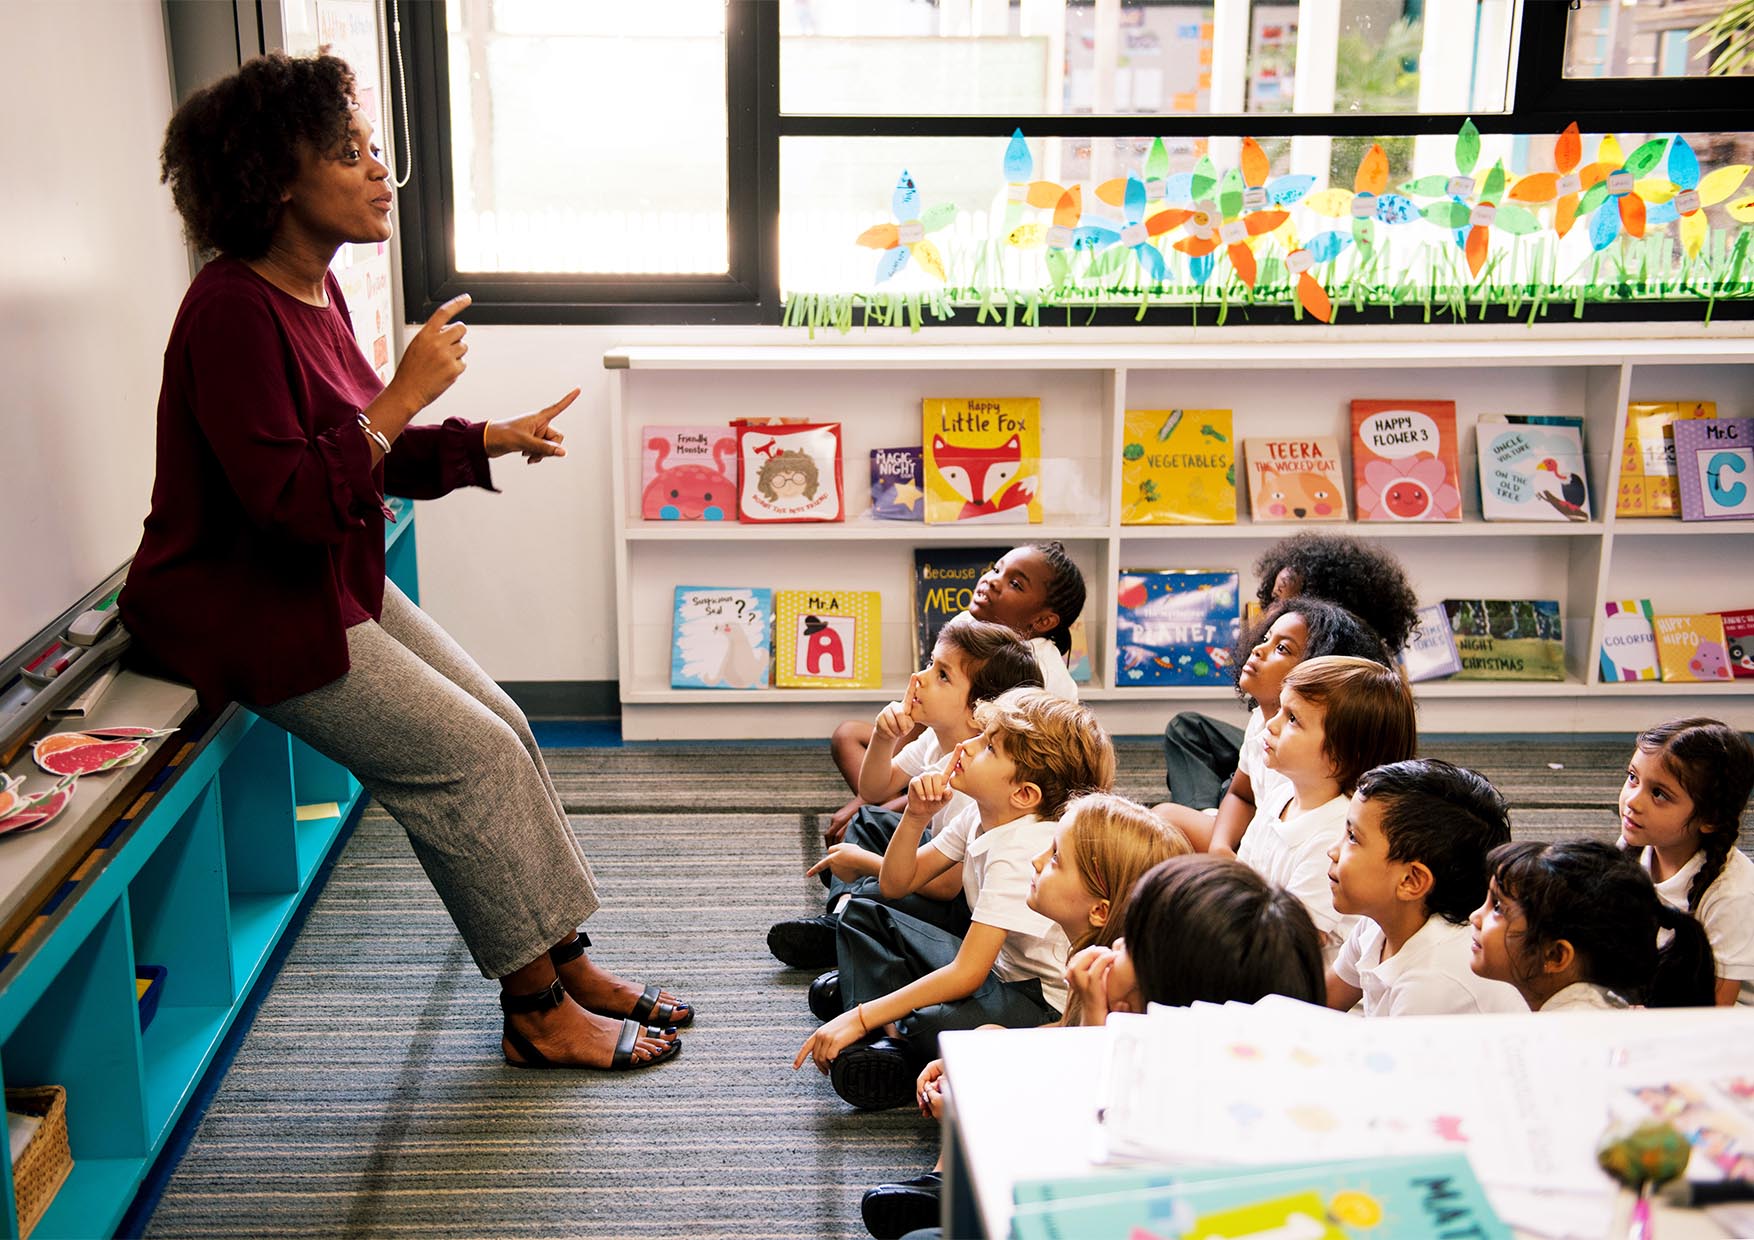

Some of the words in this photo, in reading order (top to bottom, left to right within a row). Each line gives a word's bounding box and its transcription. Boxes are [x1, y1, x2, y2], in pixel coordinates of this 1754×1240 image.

[968, 400, 1000, 414] Happy
[942, 413, 990, 432] Little
[998, 413, 1026, 432] Fox
[1375, 416, 1412, 432] HAPPY
[1373, 430, 1419, 447] FLOWER
[1420, 429, 1429, 441] 3
[1706, 425, 1738, 439] Mr.C
[677, 433, 708, 446] Friendly
[1493, 434, 1524, 454] UNCLE
[677, 445, 709, 454] Monster
[1266, 442, 1323, 460] TEERA
[876, 452, 912, 464] MAGIC
[1147, 454, 1227, 468] VEGETABLES
[879, 463, 916, 475] NIGHT
[1276, 461, 1314, 472] WICKED
[1317, 461, 1336, 472] CAT
[1495, 470, 1509, 479] ON
[1500, 480, 1520, 492] OLD
[923, 563, 976, 579] Because
[808, 597, 839, 610] Mr.A
[924, 587, 975, 614] MEO
[705, 606, 722, 615] Seal
[1132, 623, 1217, 644] PLANET
[1662, 631, 1699, 647] HIPPO
[1460, 639, 1494, 651] NIGHT
[1462, 658, 1524, 671] CHRISTMAS
